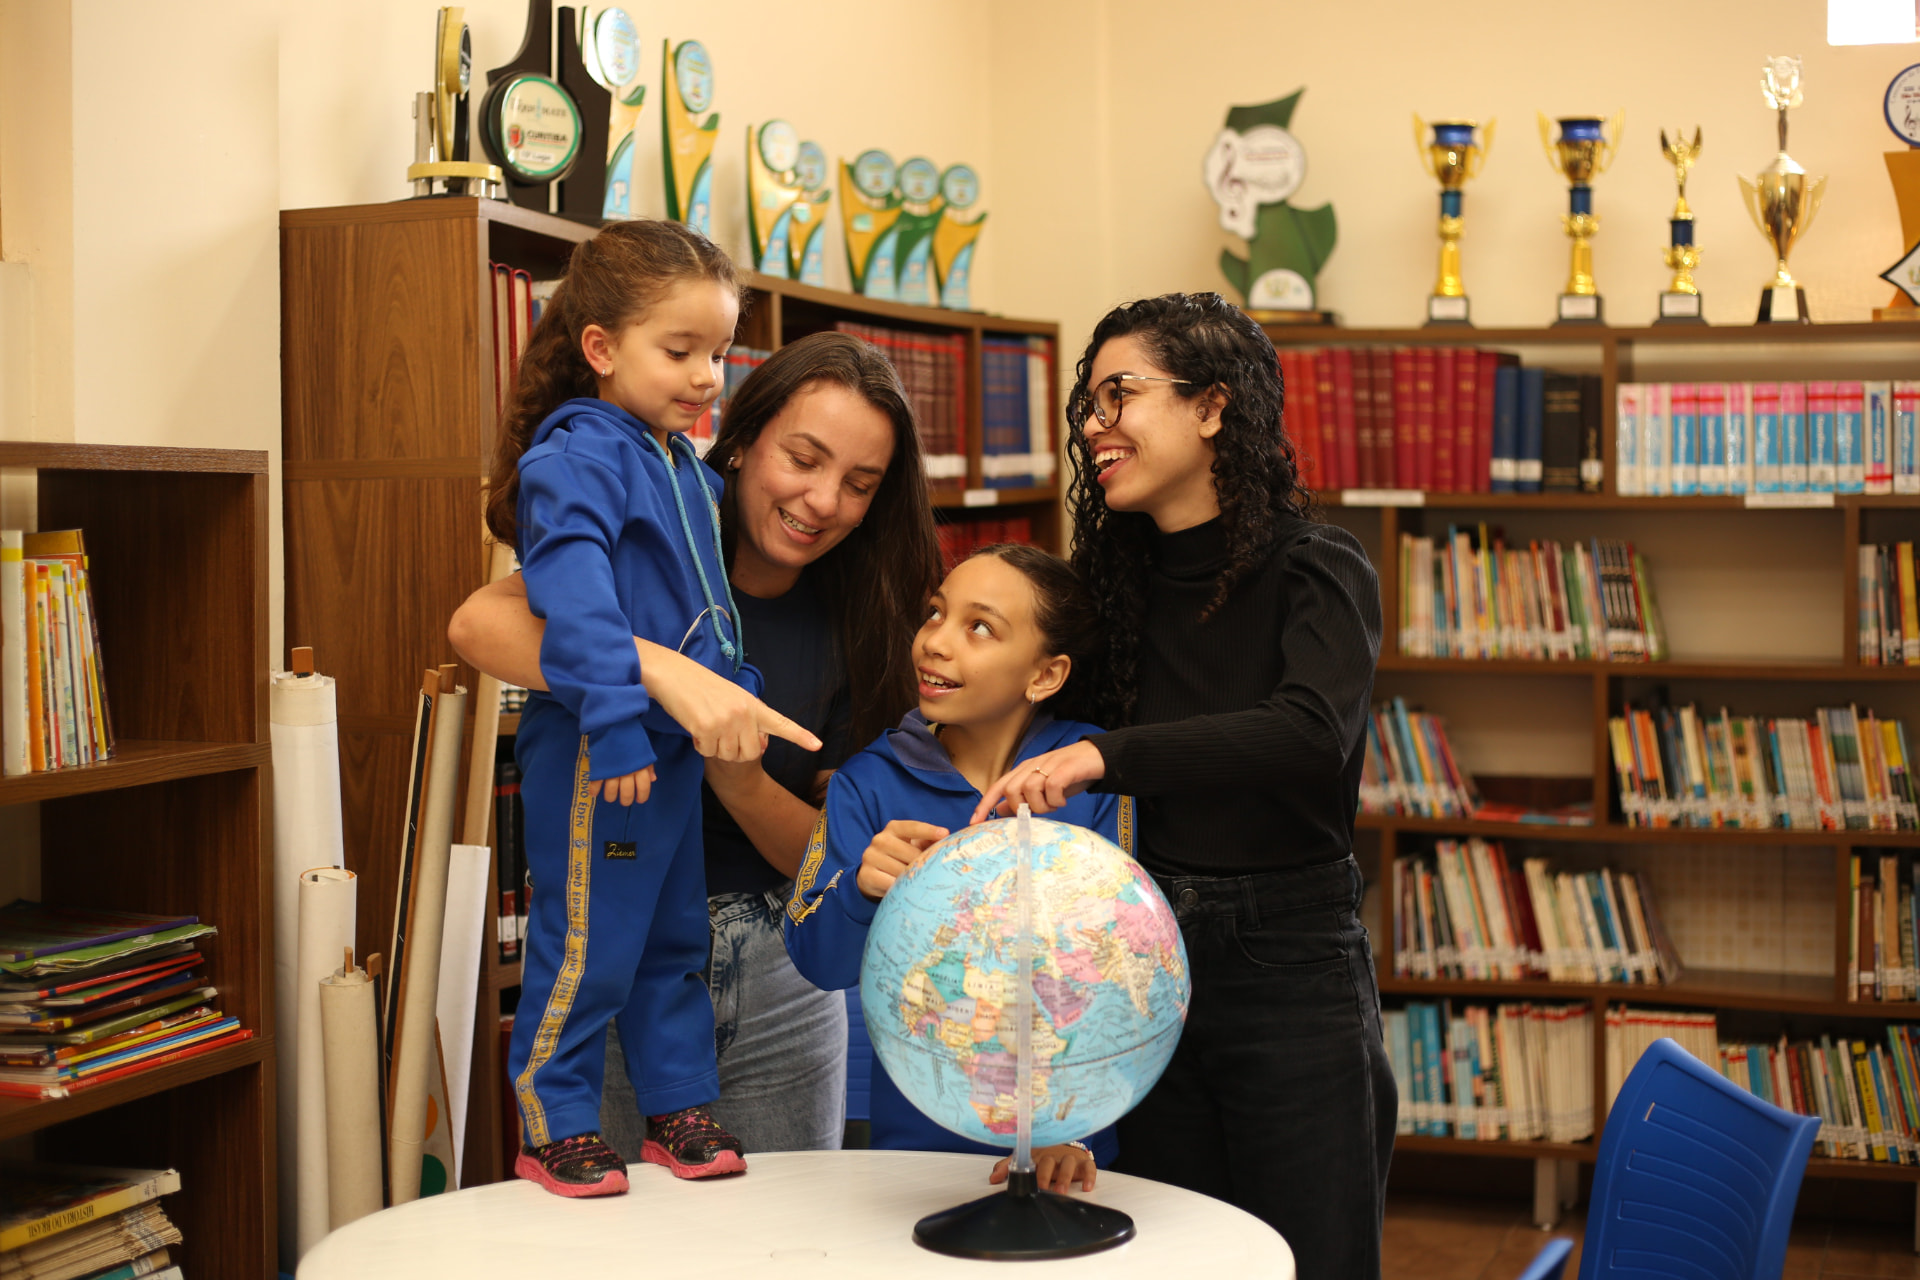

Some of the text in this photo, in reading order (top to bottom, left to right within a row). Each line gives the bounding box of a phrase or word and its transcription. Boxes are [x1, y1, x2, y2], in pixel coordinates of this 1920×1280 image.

[526, 130, 568, 142] CURITIBA
[575, 771, 590, 828] NOVO ÉDEN
[572, 860, 584, 918] NOVO ÉDEN
[557, 948, 579, 1000] NOVO ÉDEN
[52, 1217, 62, 1229] DO
[63, 1205, 94, 1225] HISTÓRIA
